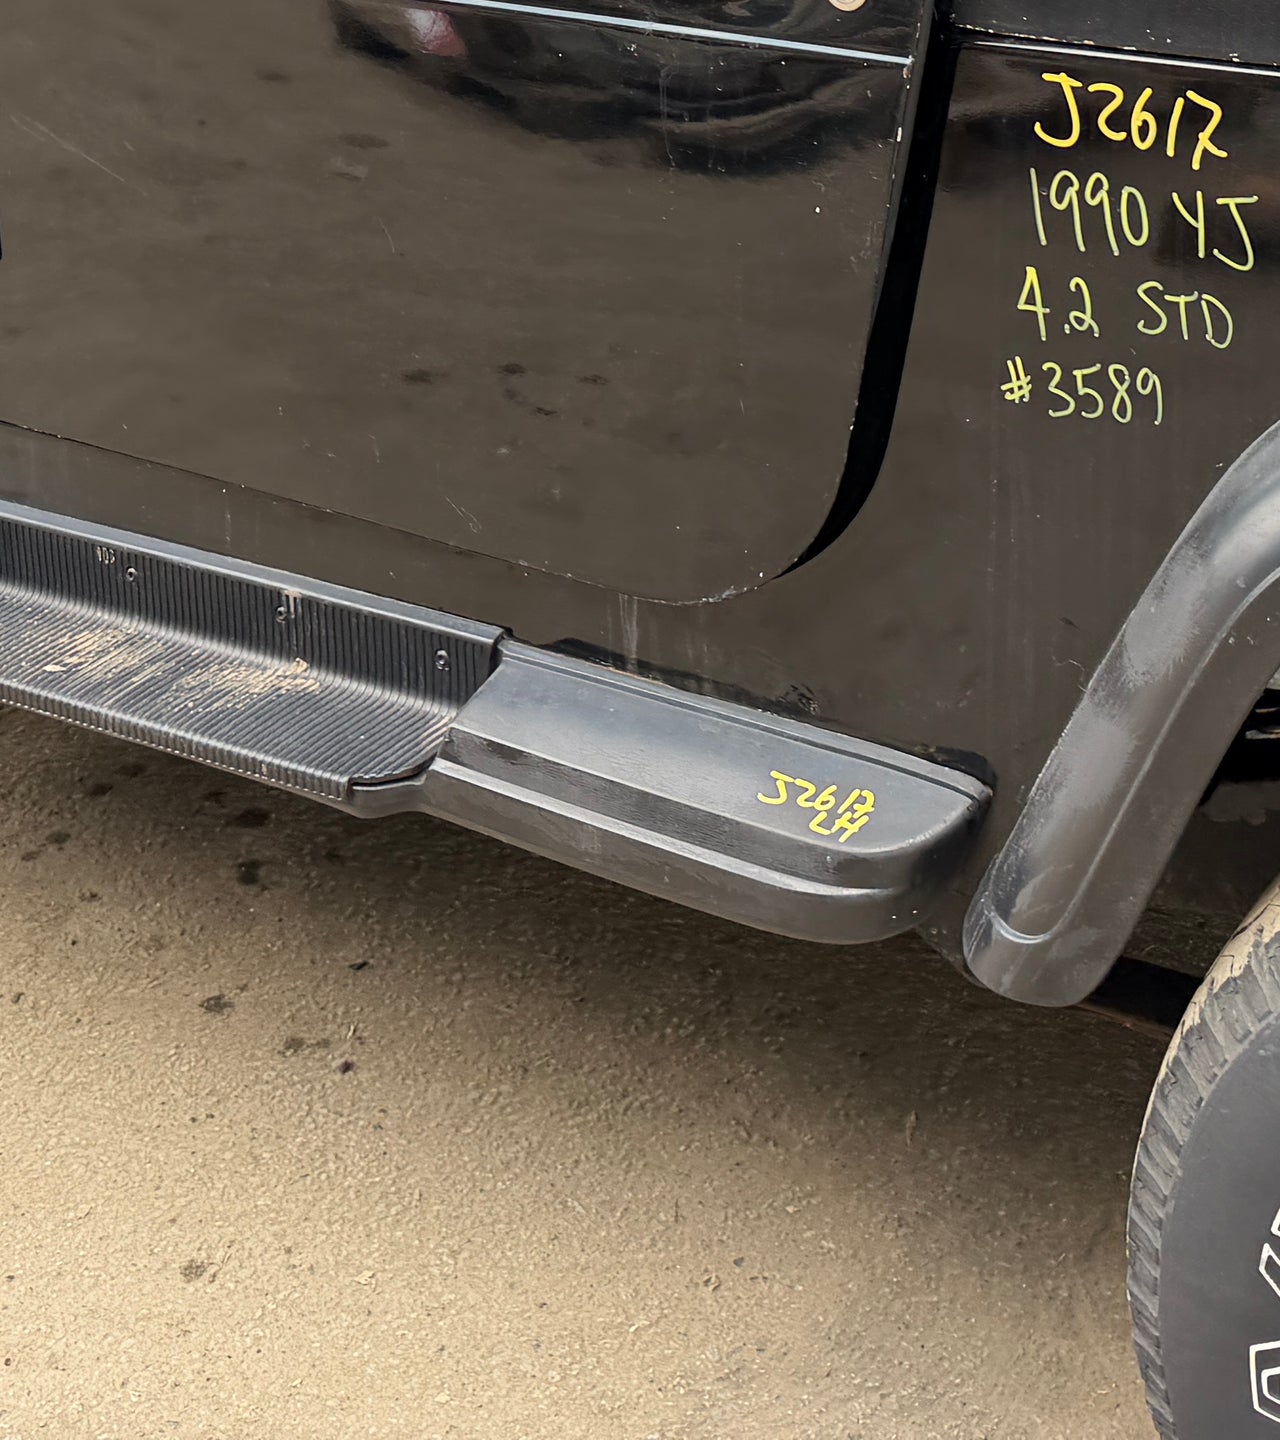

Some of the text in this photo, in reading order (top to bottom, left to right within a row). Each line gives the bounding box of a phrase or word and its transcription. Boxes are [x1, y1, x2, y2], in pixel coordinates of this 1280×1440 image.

[1033, 71, 1229, 171] J2617
[1029, 166, 1260, 272] 1990 YJ
[1016, 265, 1234, 350] 4.2 STD
[1000, 355, 1164, 427] #3589
[756, 769, 876, 820] J2617
[808, 810, 870, 844] LH
